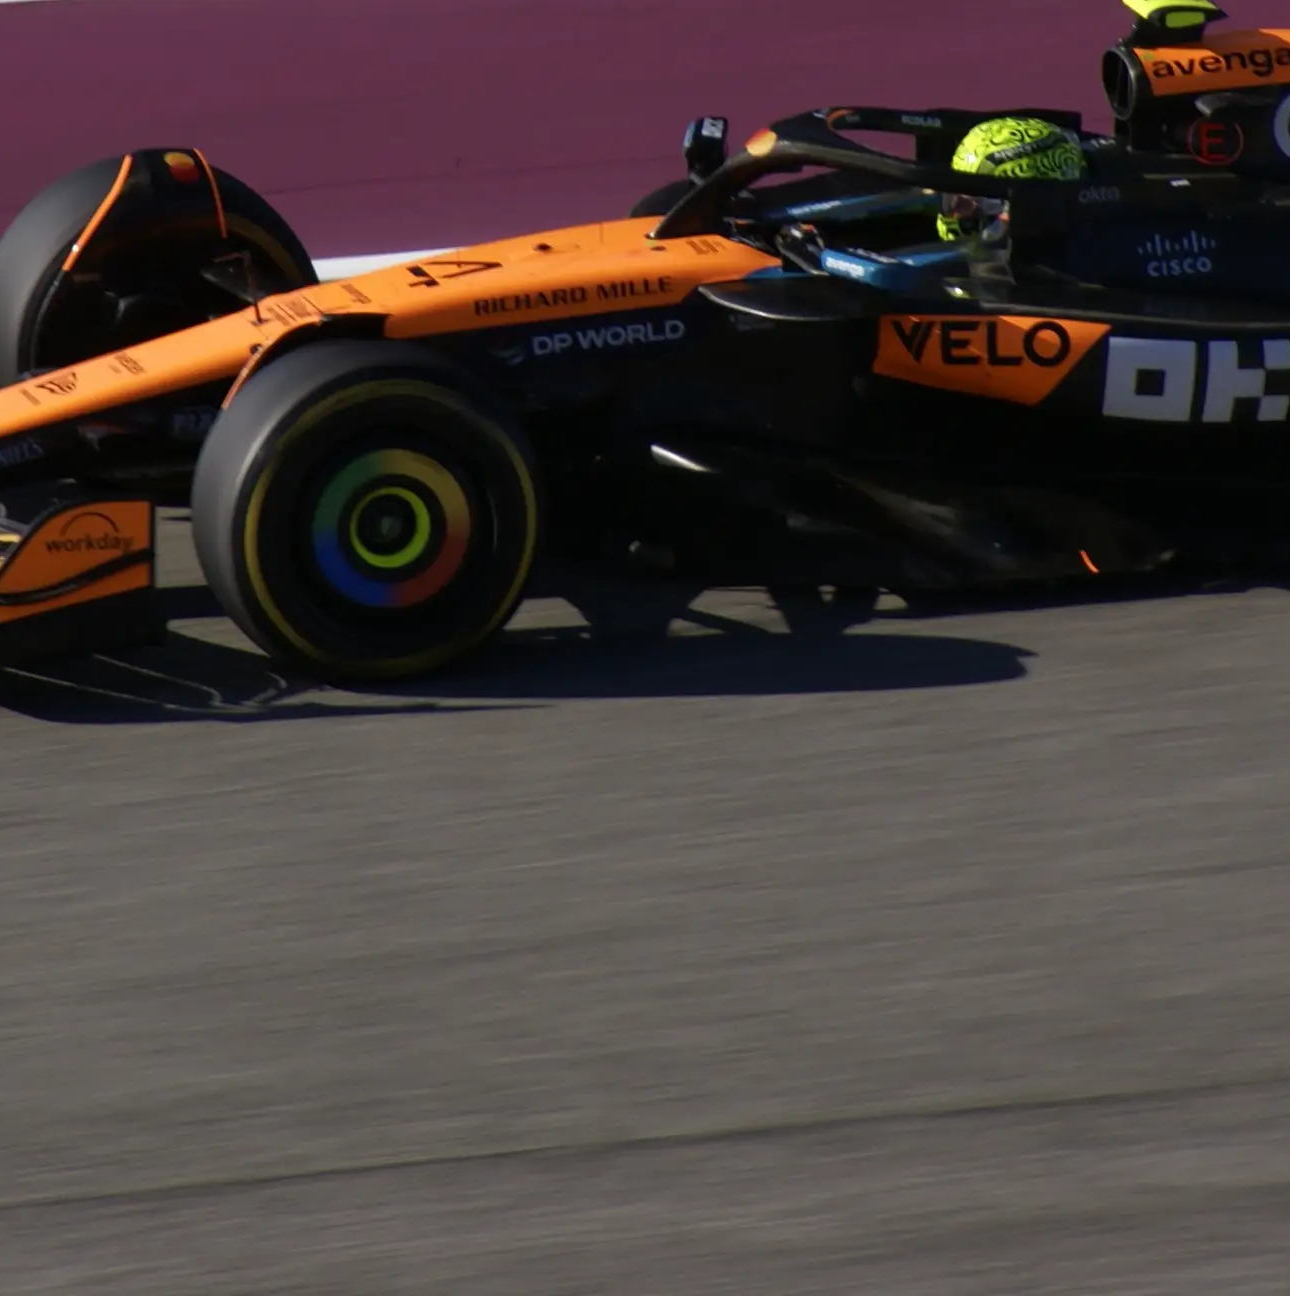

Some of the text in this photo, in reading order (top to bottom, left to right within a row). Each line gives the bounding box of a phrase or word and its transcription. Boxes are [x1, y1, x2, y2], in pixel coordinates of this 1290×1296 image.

[1147, 255, 1213, 277] cisco
[473, 276, 675, 317] RICHARD MILLE
[532, 319, 686, 357] DP WORLD
[892, 321, 1070, 366] VELO
[45, 532, 135, 554] workday
